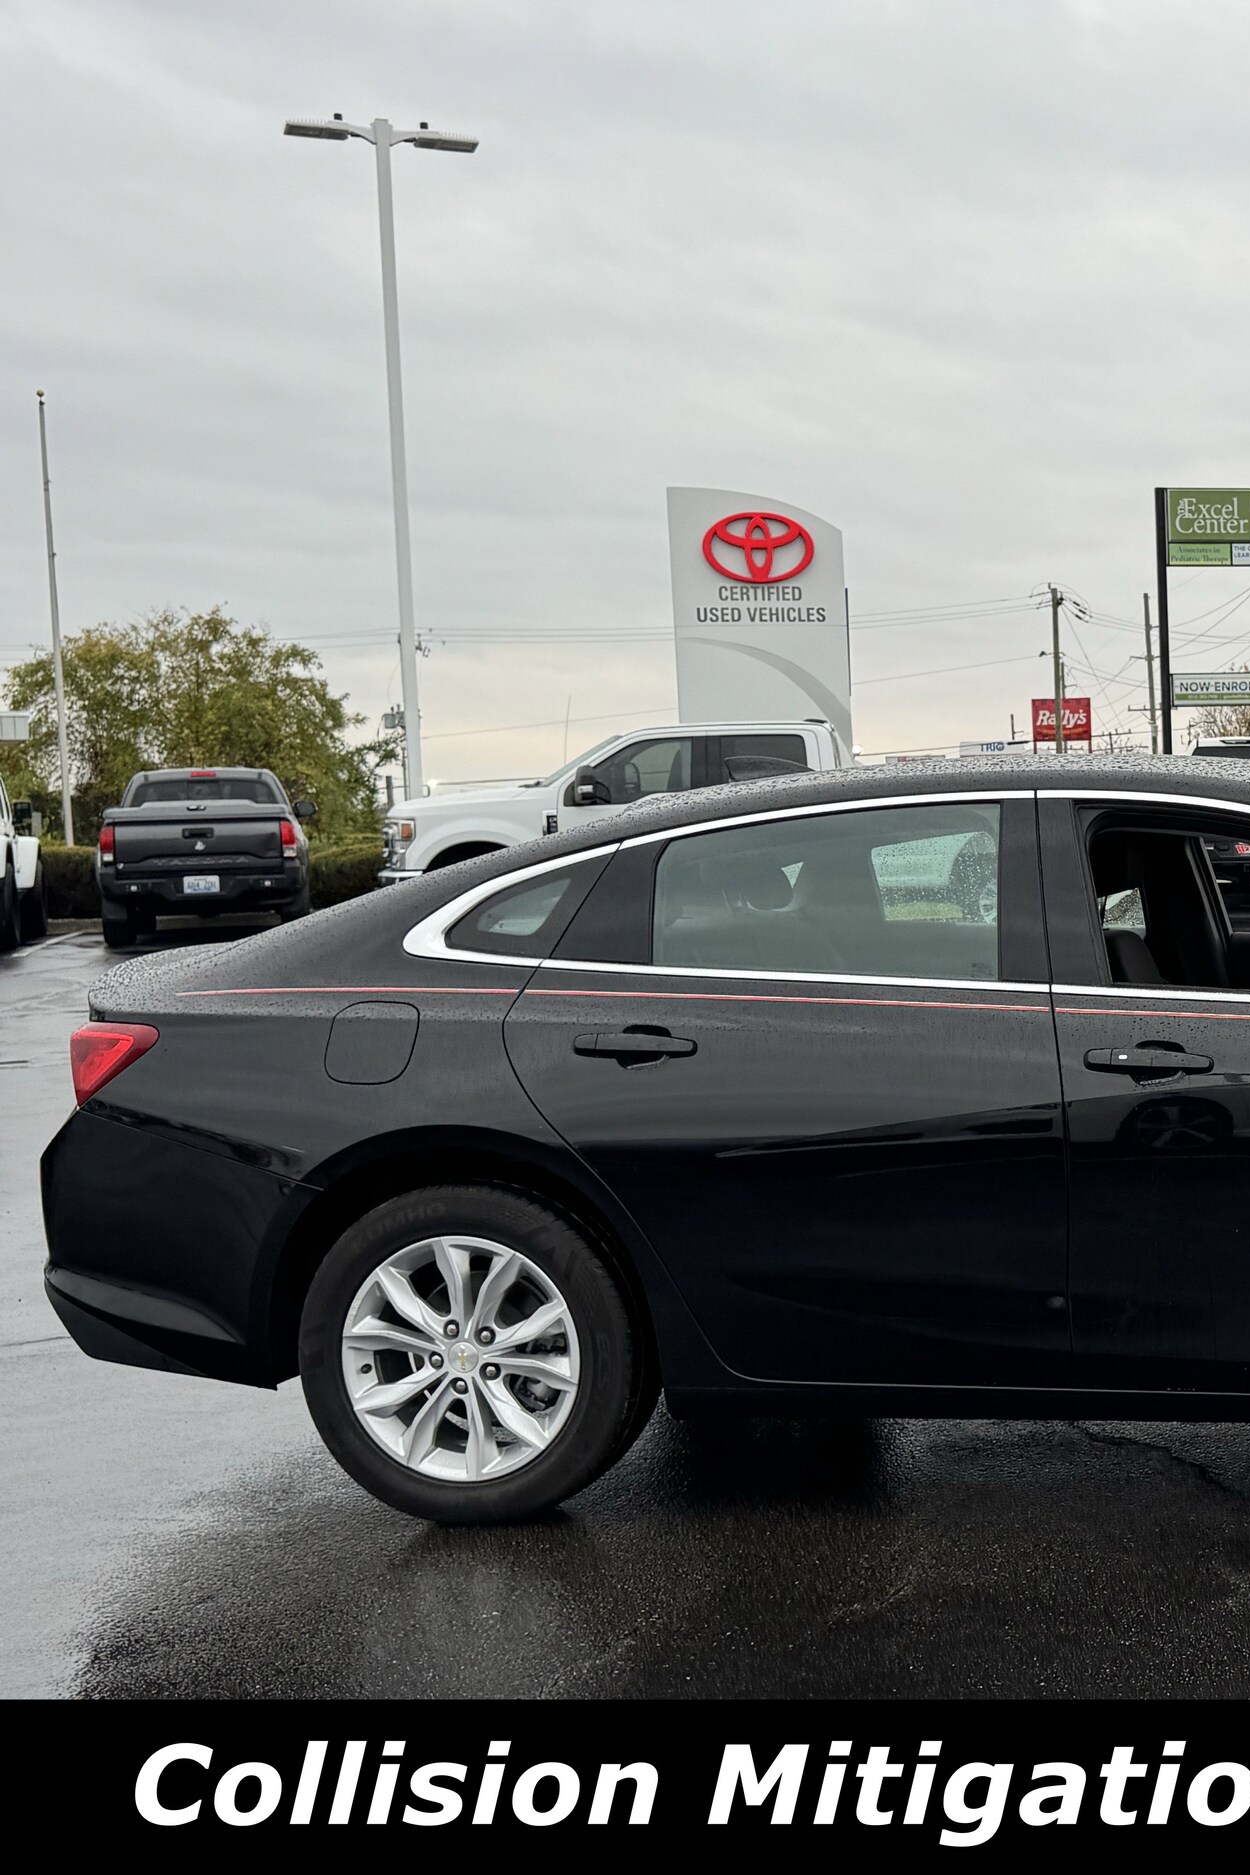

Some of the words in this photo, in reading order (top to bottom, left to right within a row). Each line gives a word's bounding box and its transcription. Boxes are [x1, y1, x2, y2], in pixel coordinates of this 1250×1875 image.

[1182, 497, 1240, 518] Excel
[1175, 514, 1248, 533] Center
[1203, 555, 1228, 564] Therapy
[718, 586, 802, 601] CERTIFIED
[696, 607, 741, 622] USED
[747, 607, 826, 622] VEHICLES
[1180, 682, 1211, 692] NOW
